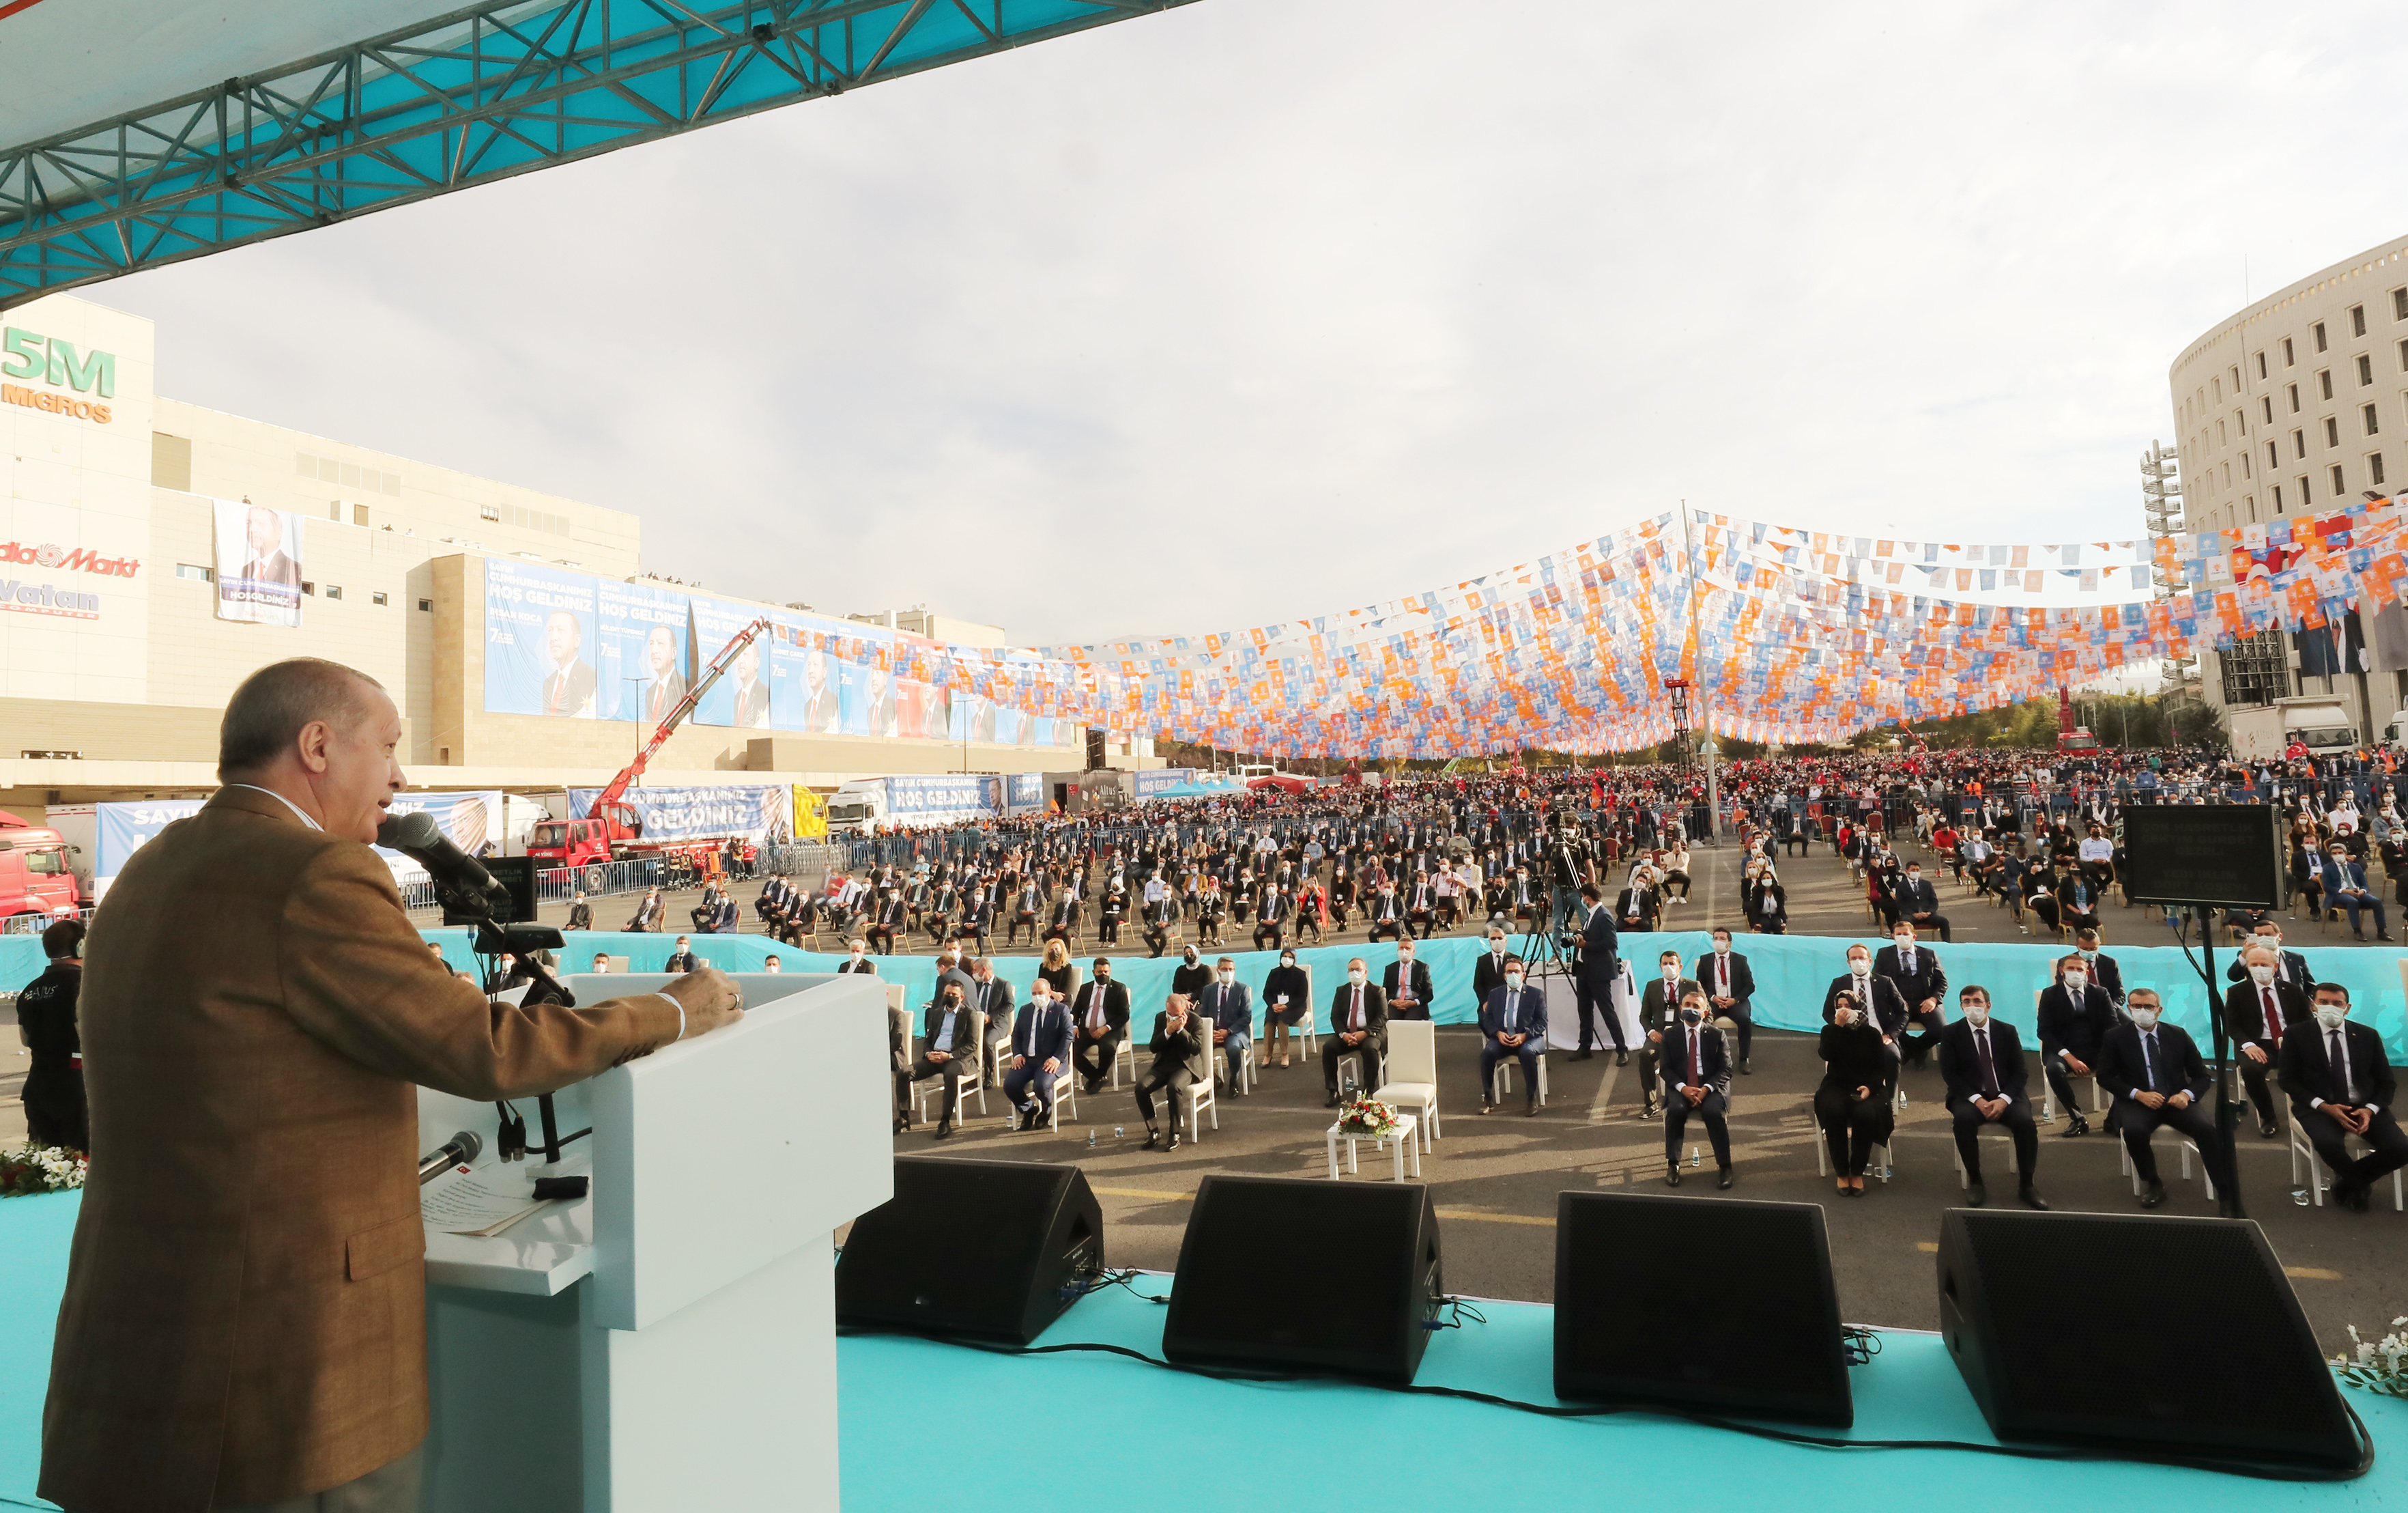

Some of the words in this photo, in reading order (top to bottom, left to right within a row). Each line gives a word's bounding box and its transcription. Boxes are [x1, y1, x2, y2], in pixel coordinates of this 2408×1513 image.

[3, 326, 115, 399] 5M
[0, 541, 36, 565] dia
[55, 548, 141, 578] Markt
[489, 563, 514, 574] SAYIN
[489, 571, 593, 597] CUMHURBAŞKANIMIZ
[600, 583, 620, 593] SAYIN
[0, 579, 99, 611] Vatan
[489, 583, 522, 604] HOŞ
[599, 591, 687, 614] CUMHURBAŞKANIMIZ
[518, 612, 543, 623] KOCA
[600, 602, 627, 620] HOŞ
[697, 617, 720, 632] HOŞ
[917, 778, 980, 787] CUMHURBAŞKANIMIZ
[1100, 784, 1116, 795] Altus
[1139, 780, 1153, 793] HOŞ
[629, 789, 746, 804] CUMHURBAŞKANIMIZ
[895, 790, 923, 809] HOŞ
[1016, 787, 1036, 802] HOŞ
